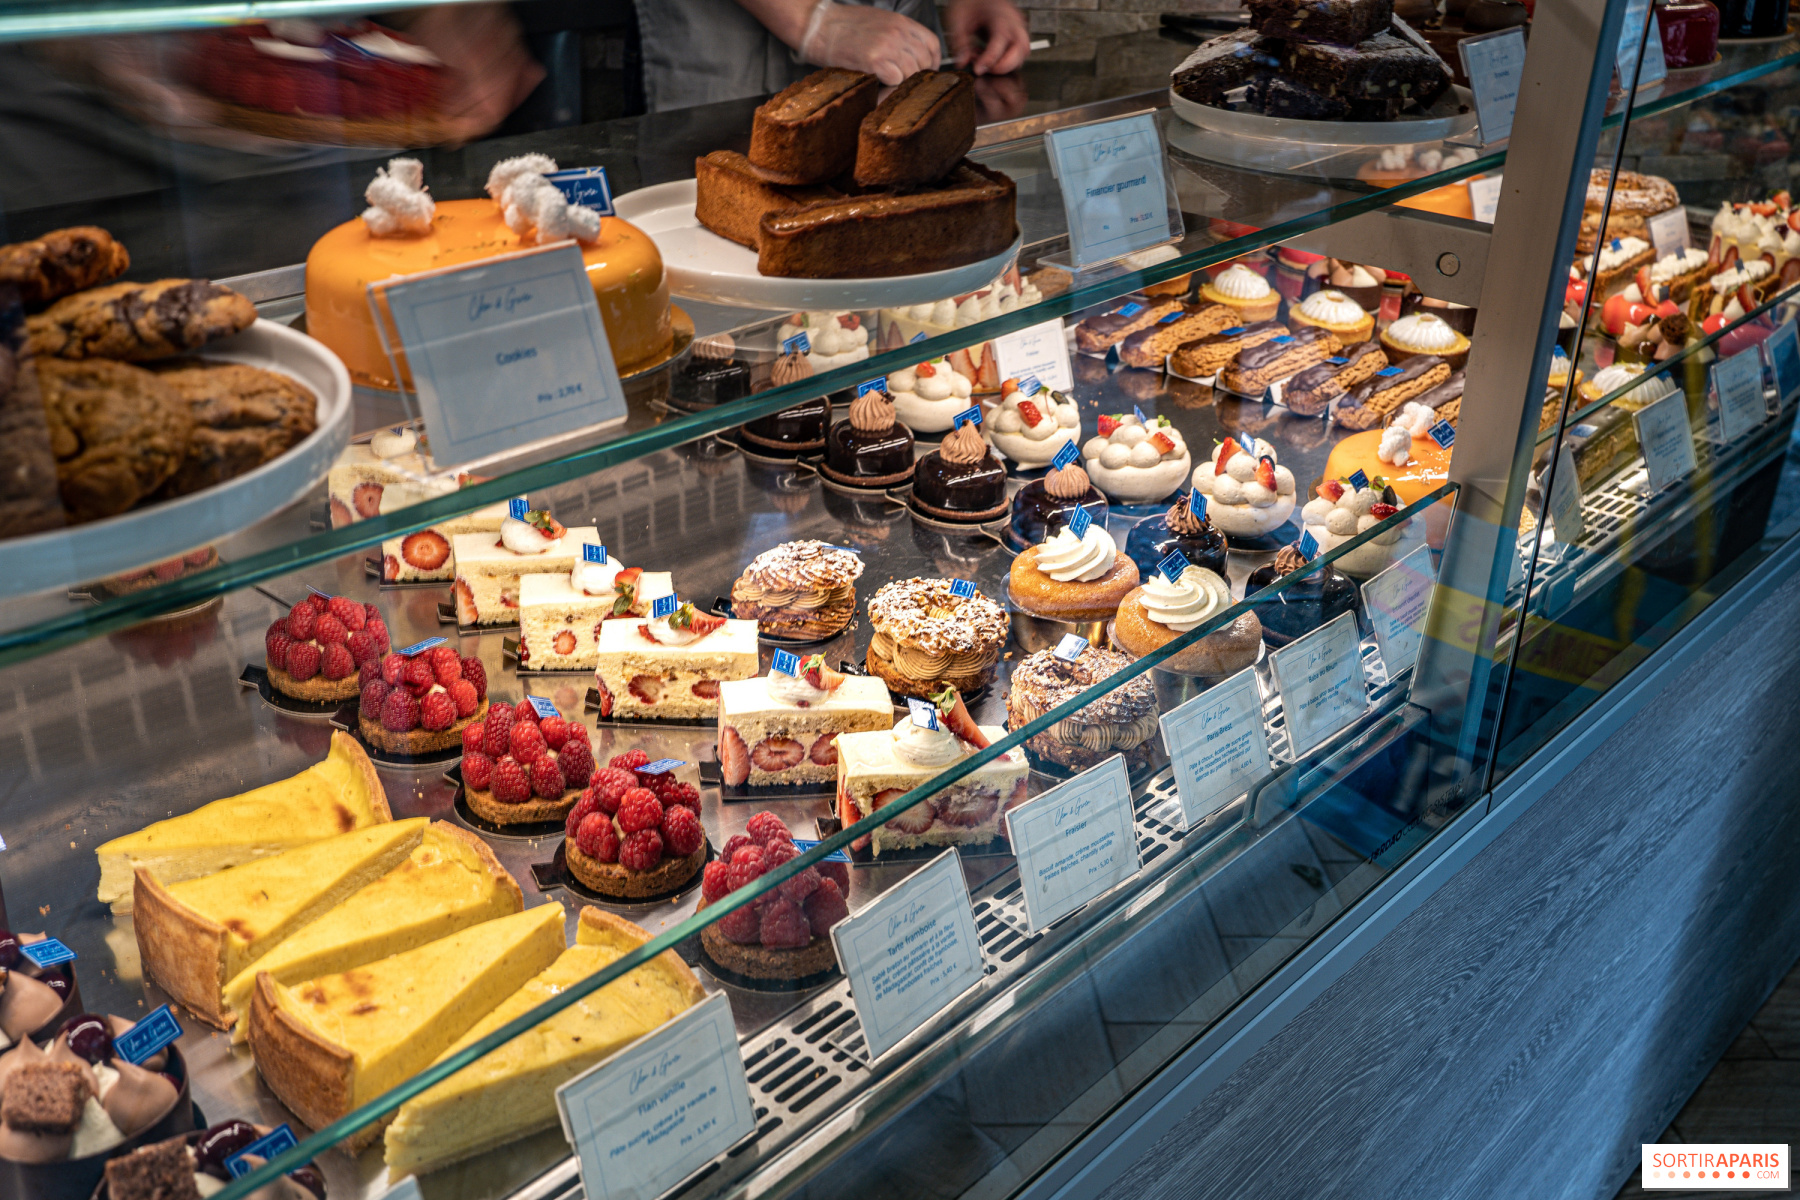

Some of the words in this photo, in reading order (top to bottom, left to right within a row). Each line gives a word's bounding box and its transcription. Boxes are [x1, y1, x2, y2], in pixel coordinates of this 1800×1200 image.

[1086, 184, 1115, 197] Financier
[1116, 175, 1146, 193] gourmand
[496, 348, 537, 365] Cookies
[1206, 723, 1233, 742] Paris-Brest
[1065, 821, 1087, 837] Fraisier
[1088, 867, 1097, 875] Prix
[887, 942, 904, 956] Tarte
[905, 919, 936, 944] framboise
[930, 977, 940, 985] Prix
[638, 1099, 657, 1115] Flan
[659, 1081, 685, 1103] vanille
[680, 1135, 692, 1145] Prix
